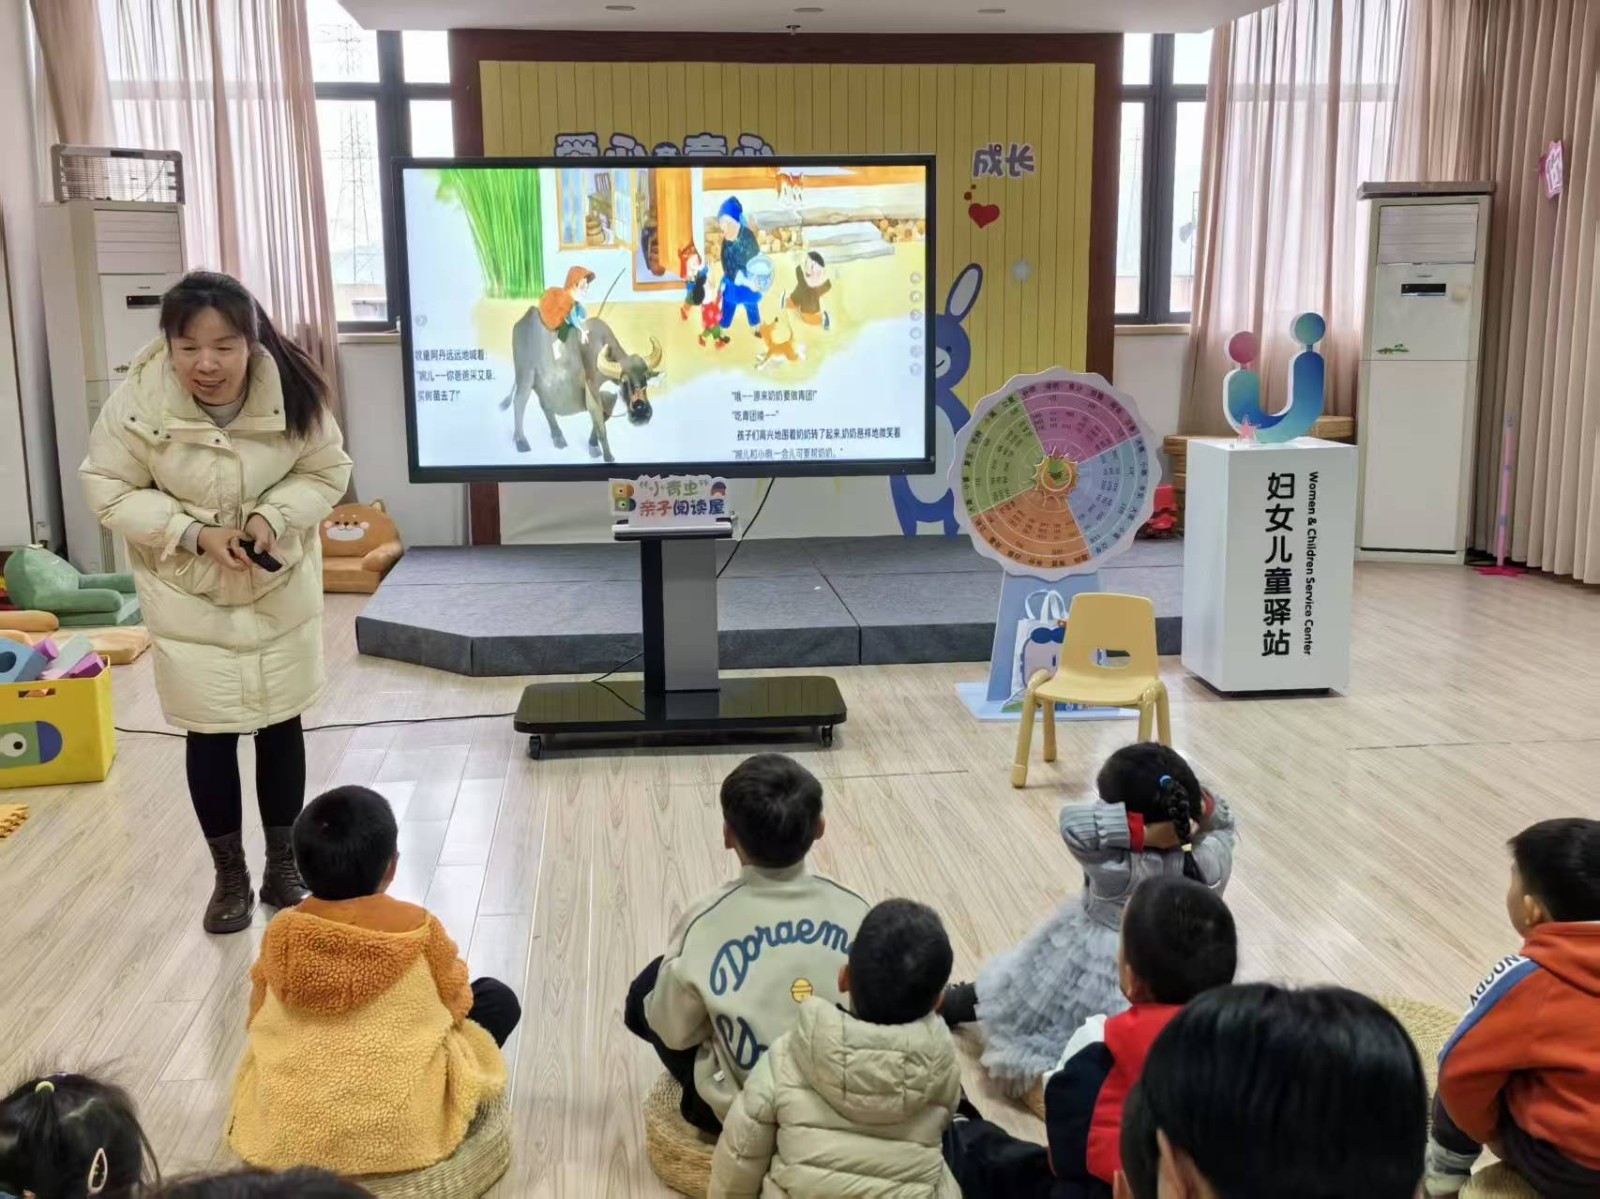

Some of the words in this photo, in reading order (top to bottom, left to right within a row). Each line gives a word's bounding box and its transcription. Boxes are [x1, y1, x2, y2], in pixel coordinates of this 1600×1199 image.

[972, 142, 1036, 178] 成长
[639, 498, 725, 517] 亲子阅读屋
[1308, 471, 1319, 515] Women
[1307, 516, 1318, 526] &
[1262, 472, 1296, 657] 妇女儿童驿站
[1306, 528, 1318, 576] Children
[1305, 577, 1316, 618] Service
[1303, 619, 1314, 656] Center
[709, 918, 852, 996] Doraem
